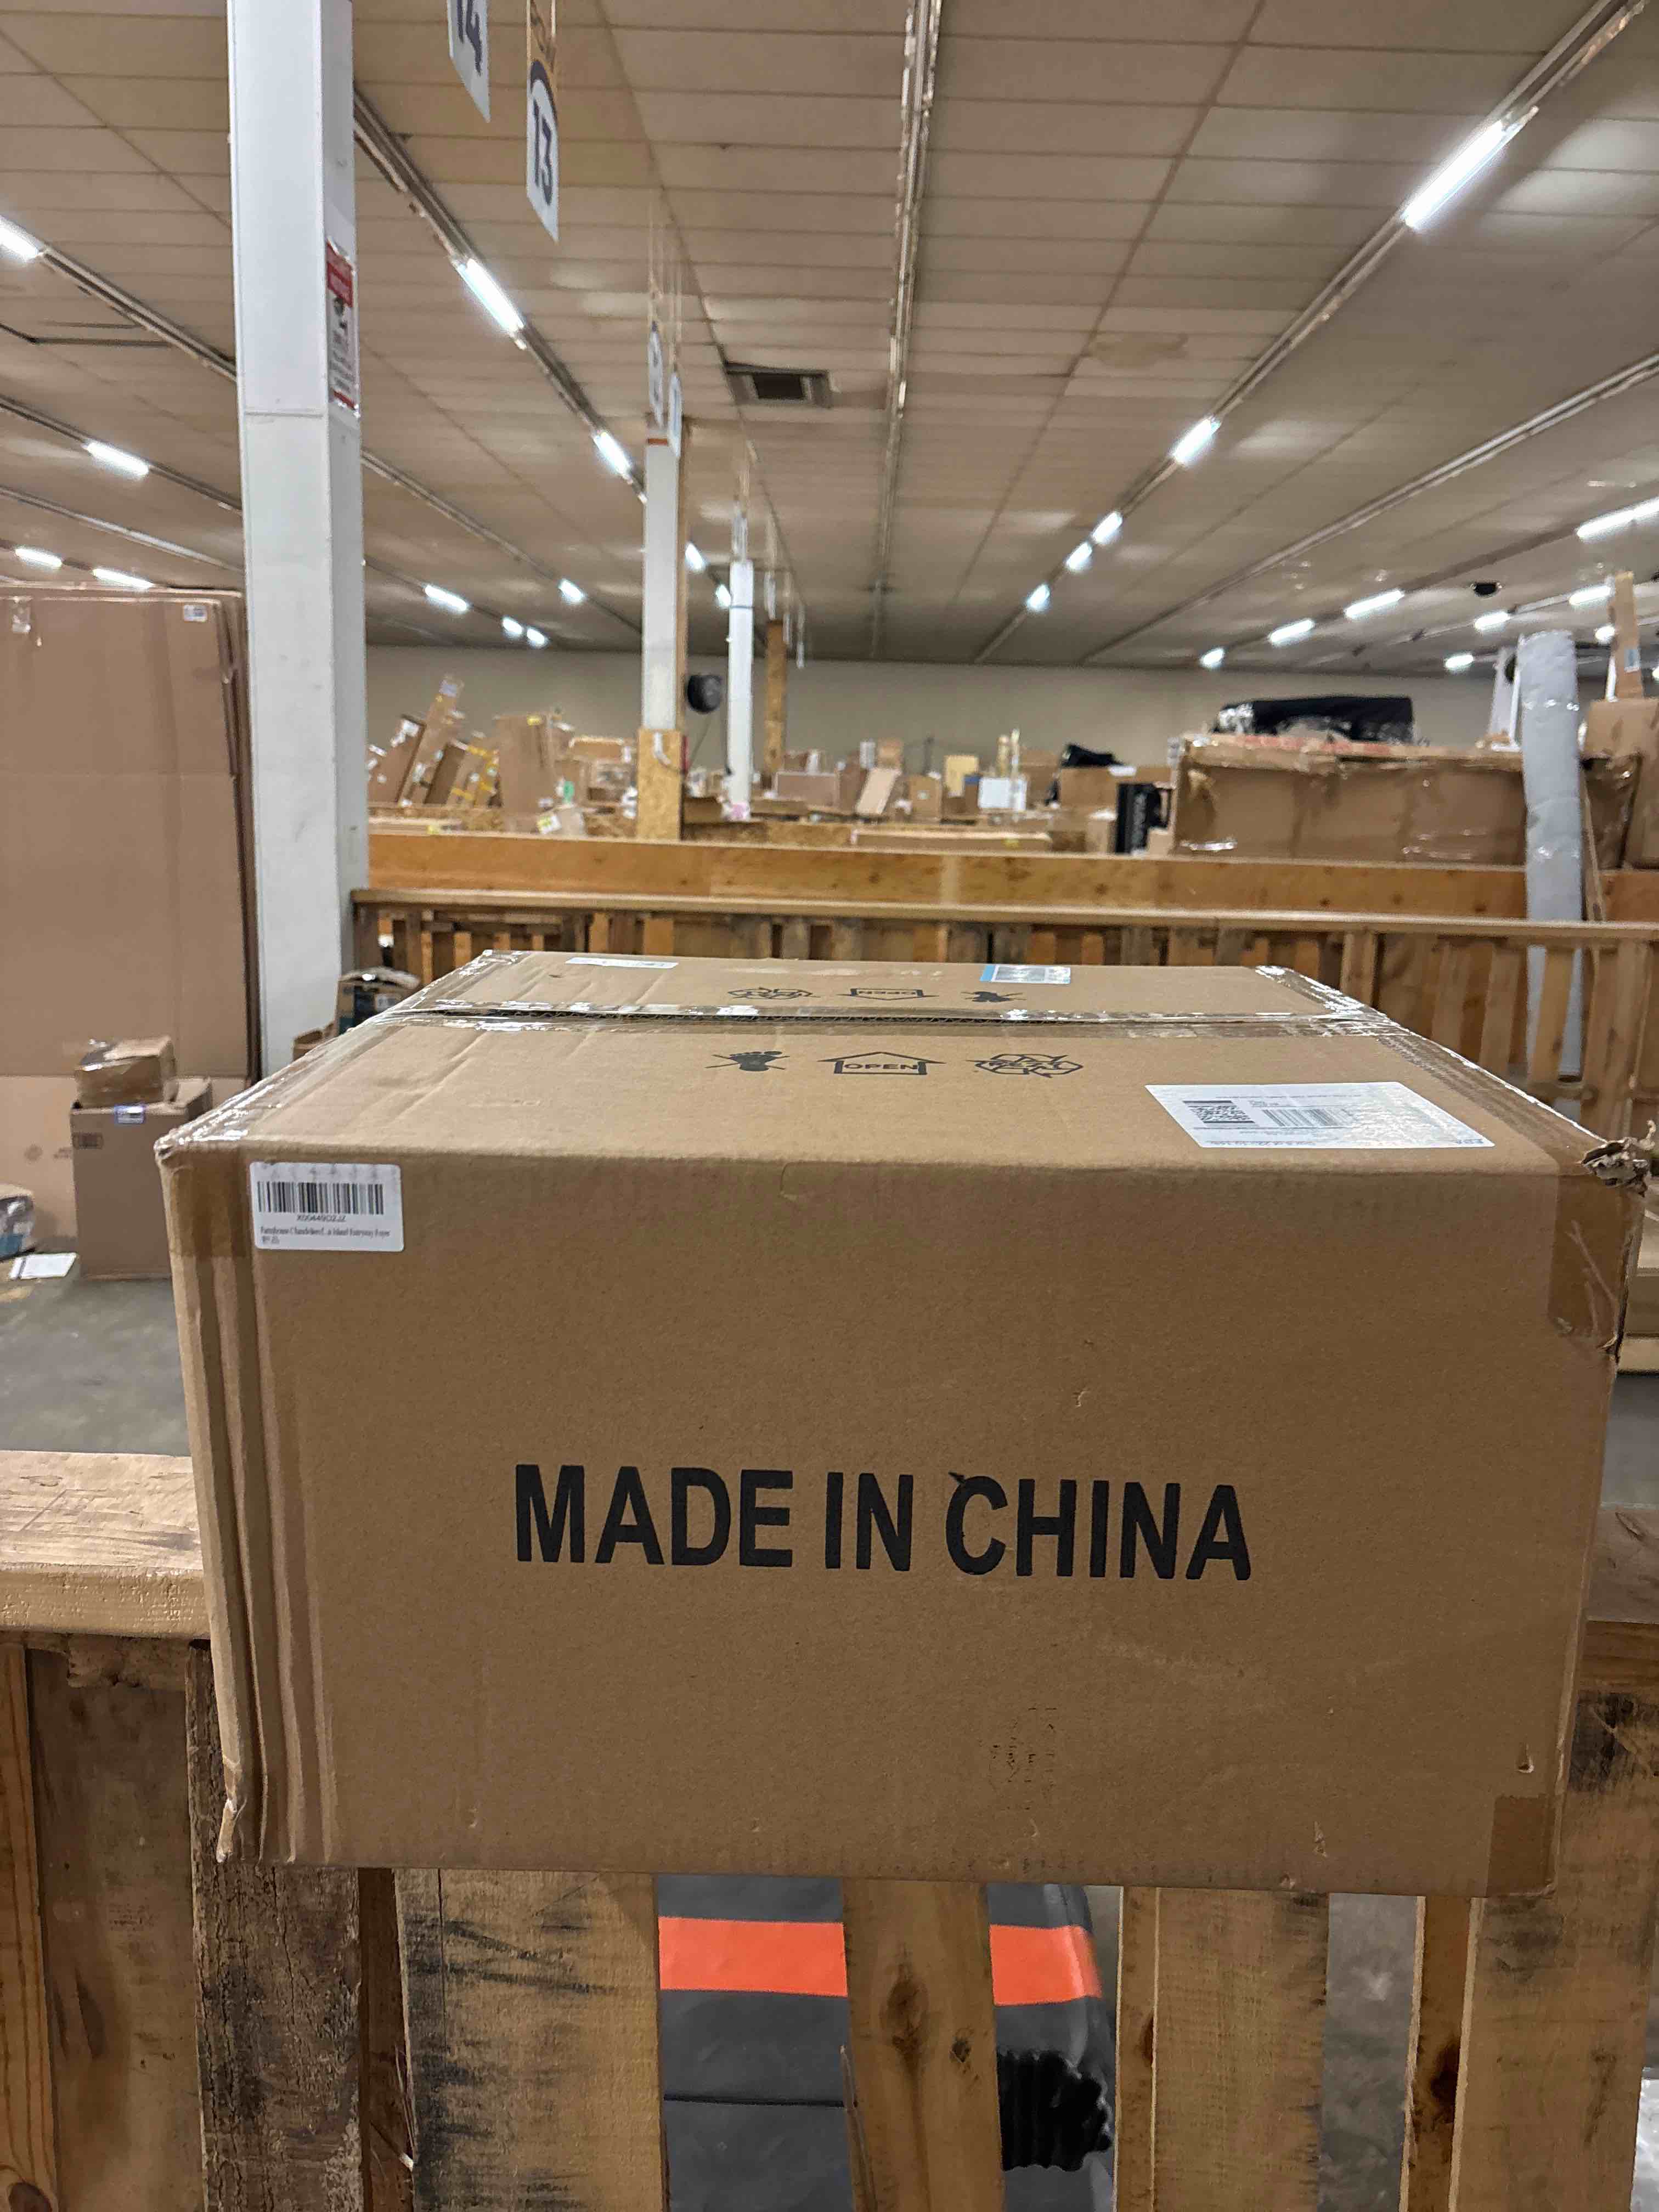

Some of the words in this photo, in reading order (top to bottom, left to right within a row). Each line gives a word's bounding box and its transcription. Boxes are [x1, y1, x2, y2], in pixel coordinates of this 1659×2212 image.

[516, 1464, 793, 1567] MADE
[825, 1472, 913, 1571] IN
[946, 1475, 1251, 1581] CHINA
